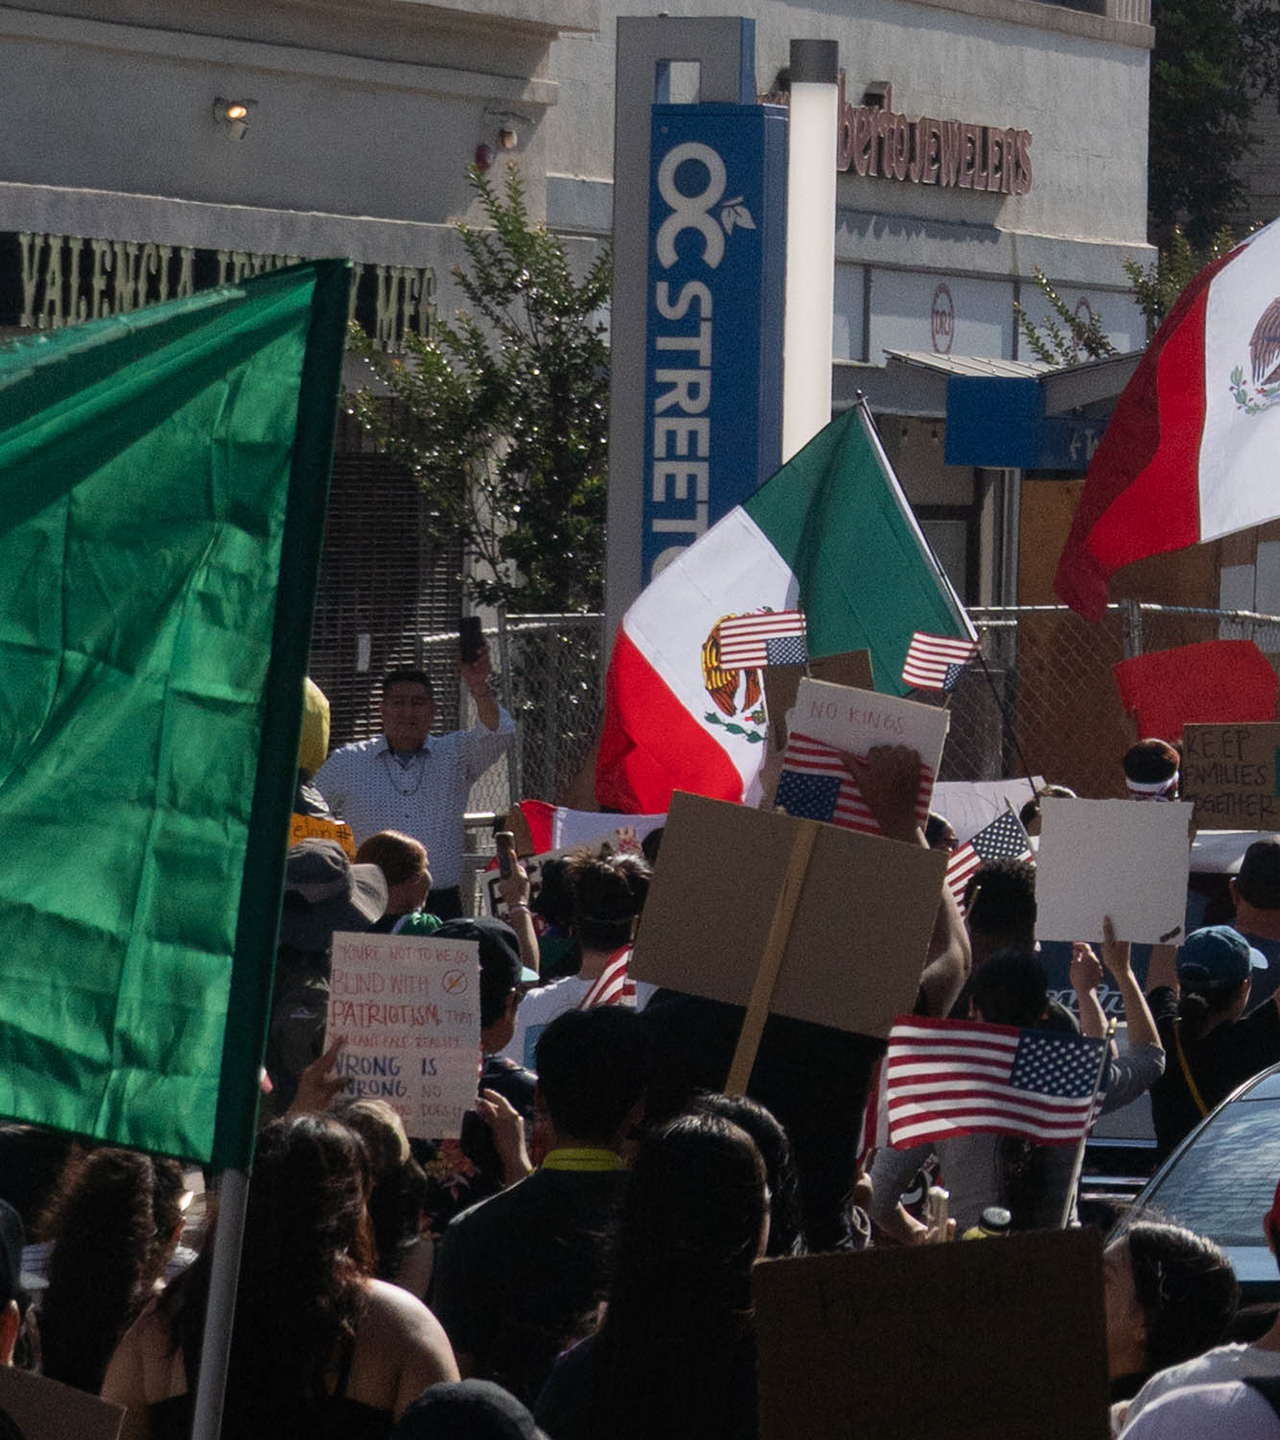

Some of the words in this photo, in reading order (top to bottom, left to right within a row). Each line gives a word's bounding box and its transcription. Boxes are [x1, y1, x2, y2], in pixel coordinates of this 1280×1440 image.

[910, 116, 1033, 196] JEWELERS
[655, 141, 728, 271] OC
[651, 280, 714, 585] STREET
[810, 700, 838, 720] NO
[849, 707, 904, 733] KINGS
[1186, 730, 1251, 760] KEEP
[332, 968, 385, 995] BLIND
[390, 973, 430, 996] WITH
[330, 999, 439, 1028] PATRIOTISM
[420, 1056, 438, 1077] IS
